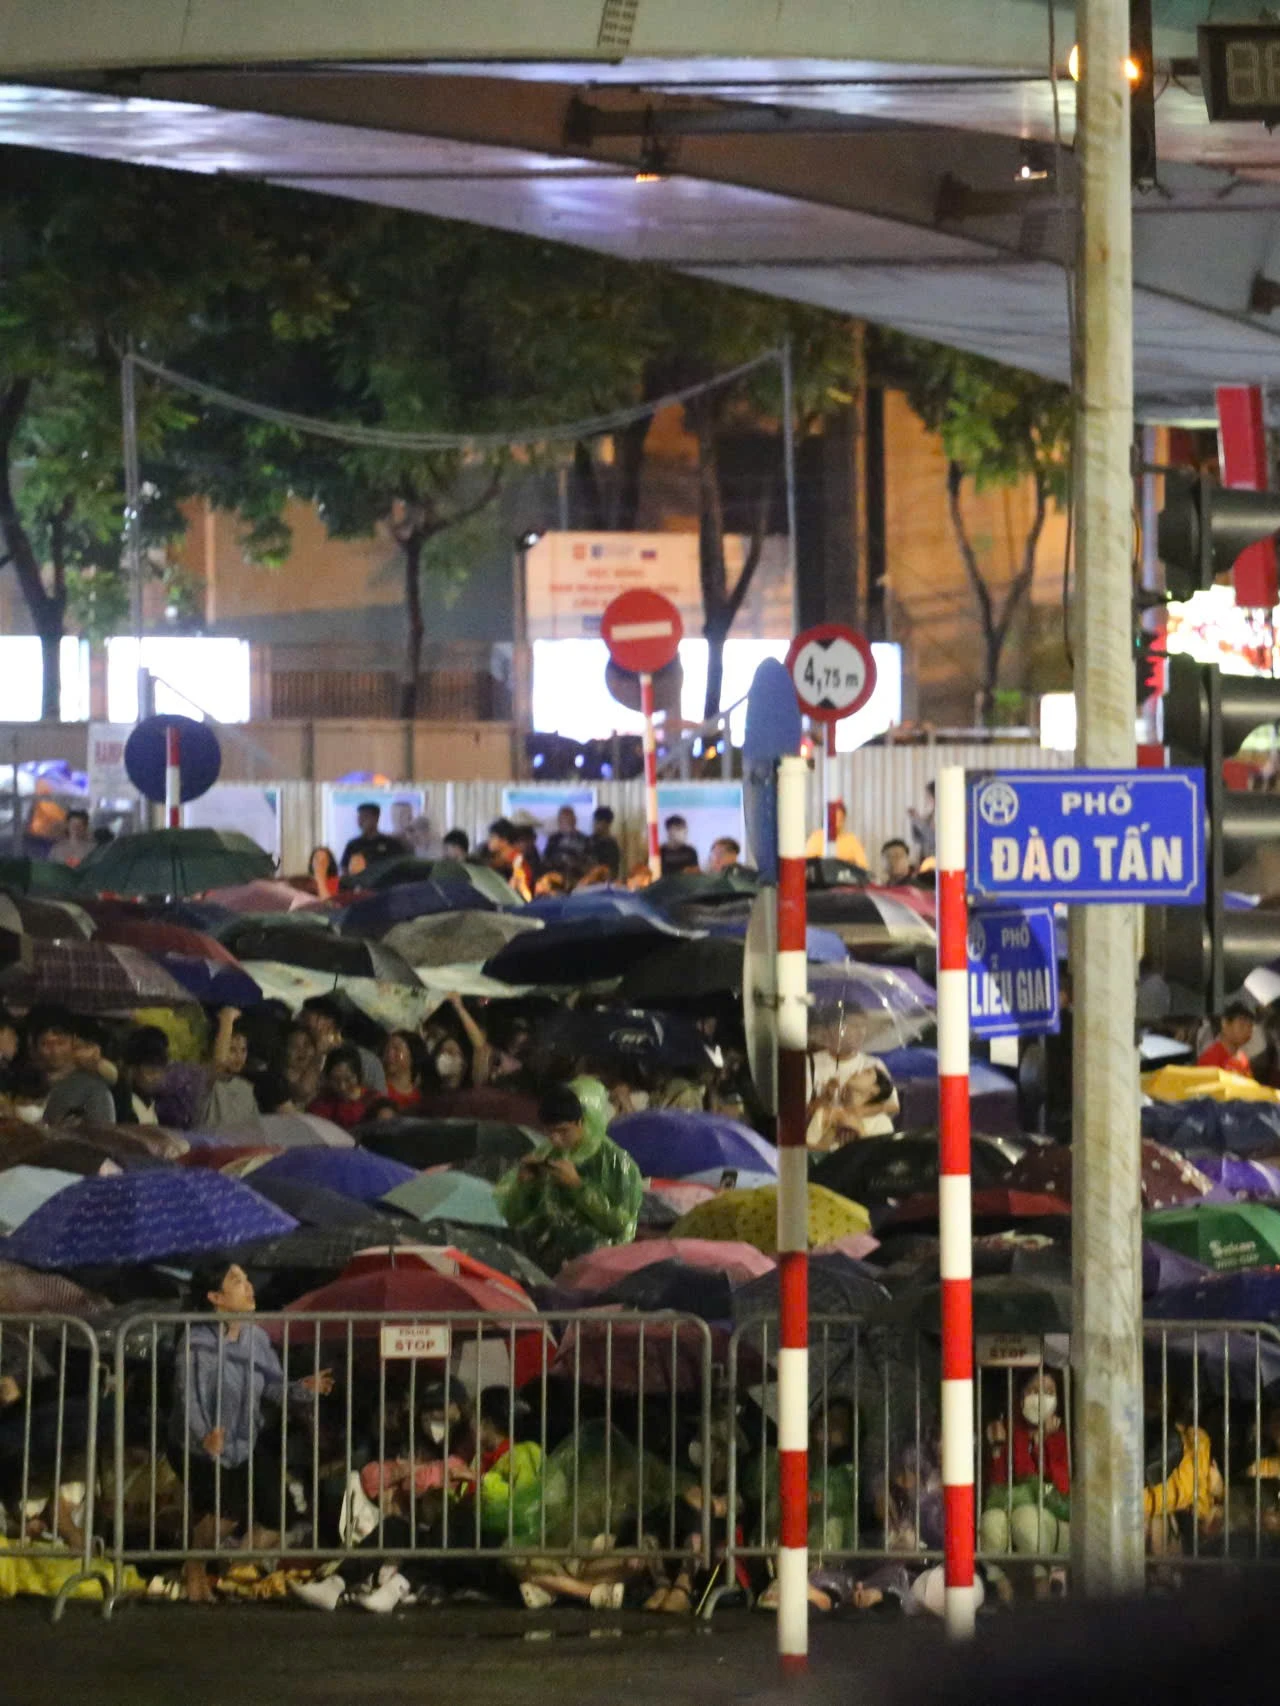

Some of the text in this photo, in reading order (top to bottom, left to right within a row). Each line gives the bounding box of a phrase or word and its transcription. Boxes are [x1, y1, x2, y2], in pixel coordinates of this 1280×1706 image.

[1061, 780, 1132, 816] PHỐ
[990, 821, 1184, 882] ĐÀO TẤN
[1015, 966, 1052, 1013] GIAI
[394, 1338, 436, 1352] STOP
[989, 1346, 1028, 1360] STOP
